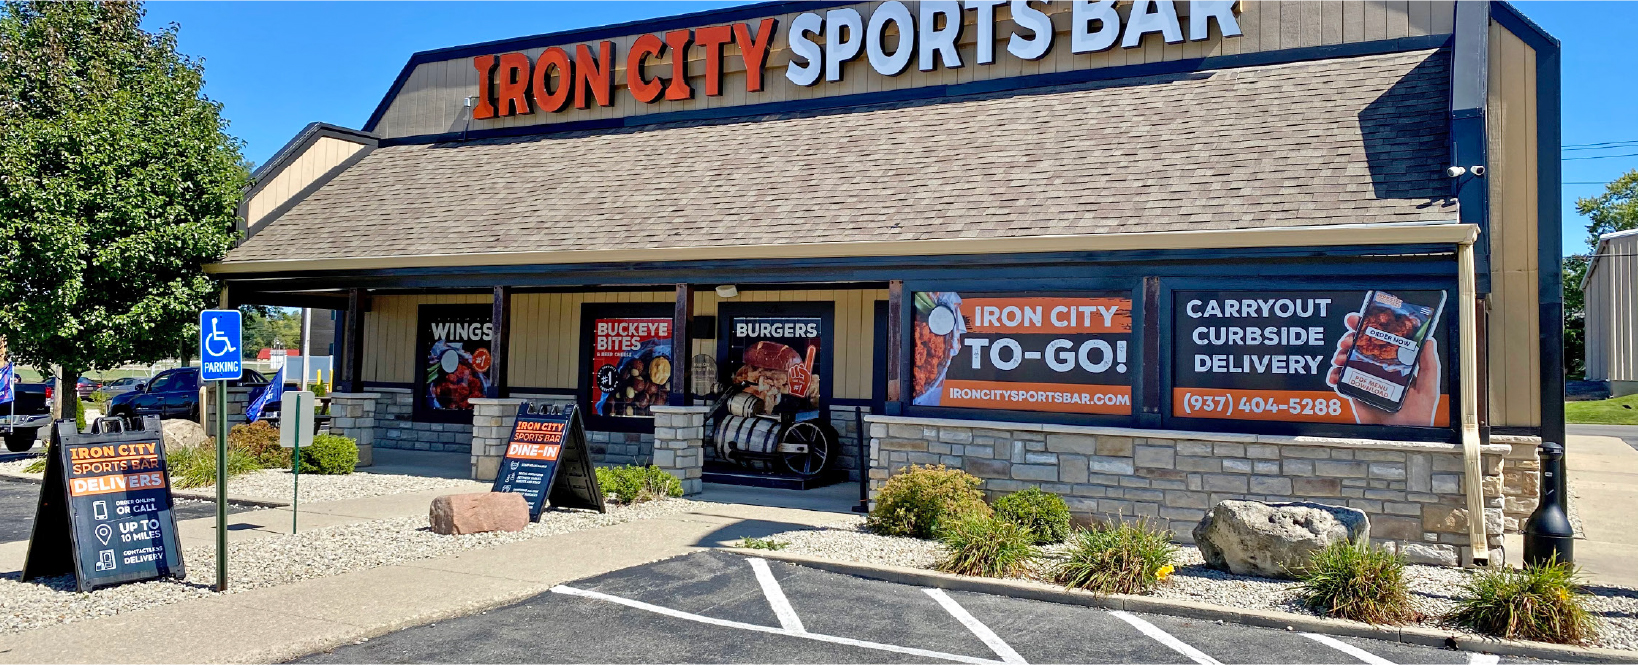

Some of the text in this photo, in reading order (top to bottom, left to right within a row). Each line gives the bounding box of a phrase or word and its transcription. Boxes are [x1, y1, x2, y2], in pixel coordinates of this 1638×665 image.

[473, 0, 1243, 119] IRON CITY SPORTS BAR
[1186, 299, 1331, 318] CARRYOUT
[975, 306, 1119, 327] IRON CITY
[431, 323, 492, 340] WINGS
[597, 323, 668, 336] BUCKEYE
[736, 323, 817, 338] BURGERS
[1192, 327, 1324, 345] CURBSIDE
[597, 336, 641, 350] BITES
[1370, 330, 1411, 347] ORDER NOW
[964, 338, 1127, 373] TO-GO!
[204, 361, 239, 373] PARKING
[1194, 355, 1323, 375] DELIVERY
[601, 371, 612, 385] #1
[1350, 380, 1389, 398] DOWNLOAD
[1369, 380, 1389, 392] MENU
[950, 388, 1130, 406] IRONCITYSPORTSBAR.COM
[1183, 393, 1342, 416] (937) 404-5288
[516, 421, 564, 432] IRON CITY
[514, 432, 561, 443] SPORTS BAR
[69, 443, 156, 459] IRON CITY
[508, 444, 557, 457] DINE-IN
[72, 458, 159, 475] SPORTS BAR
[74, 474, 162, 493] DELIVERS
[116, 503, 157, 514] OR CALL
[119, 519, 159, 533] UP TO
[121, 530, 160, 542] 10 MILES
[123, 546, 162, 555] CONTACTLESS
[124, 553, 163, 564] DELIVERY
